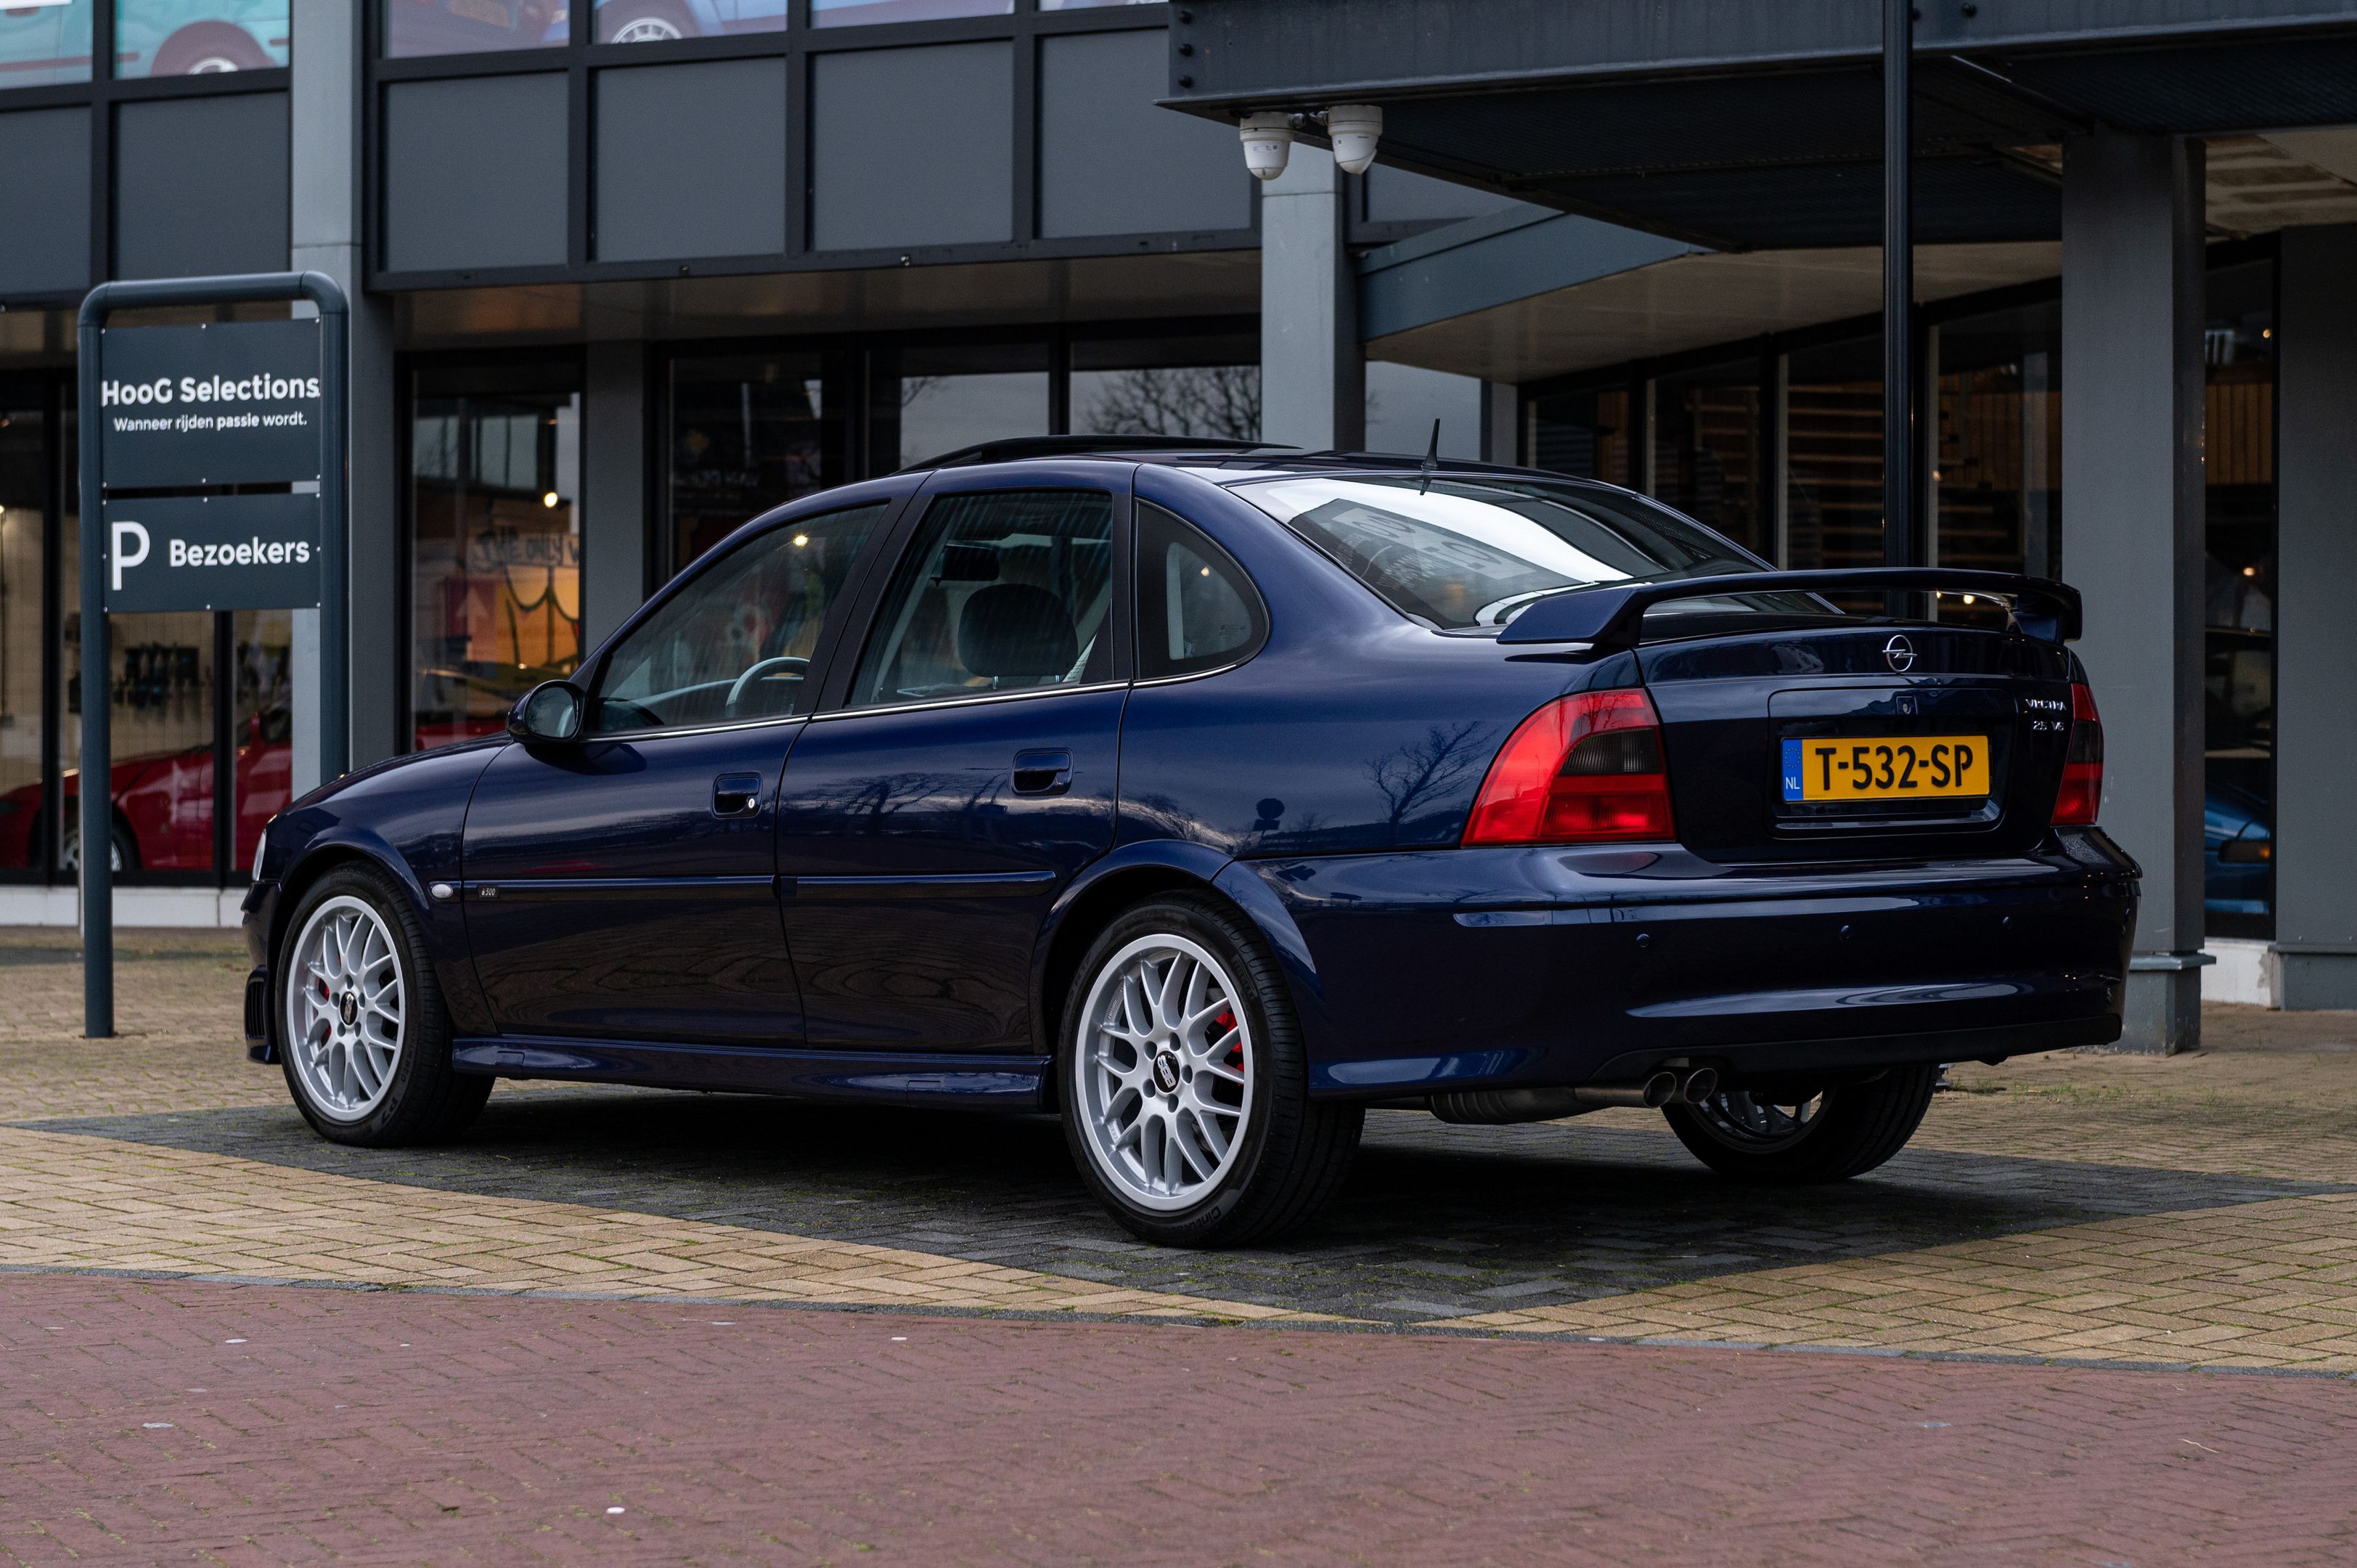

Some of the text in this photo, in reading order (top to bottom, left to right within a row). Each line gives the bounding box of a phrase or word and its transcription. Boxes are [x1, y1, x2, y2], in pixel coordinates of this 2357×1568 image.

[101, 373, 319, 407] HooG Selections
[113, 411, 307, 433] Wanneer rijden passie wordt.
[111, 520, 310, 591] P Bezoekers
[1785, 776, 1800, 791] NL
[1815, 744, 1973, 791] T-532-SP
[1157, 1055, 1176, 1088] BBS
